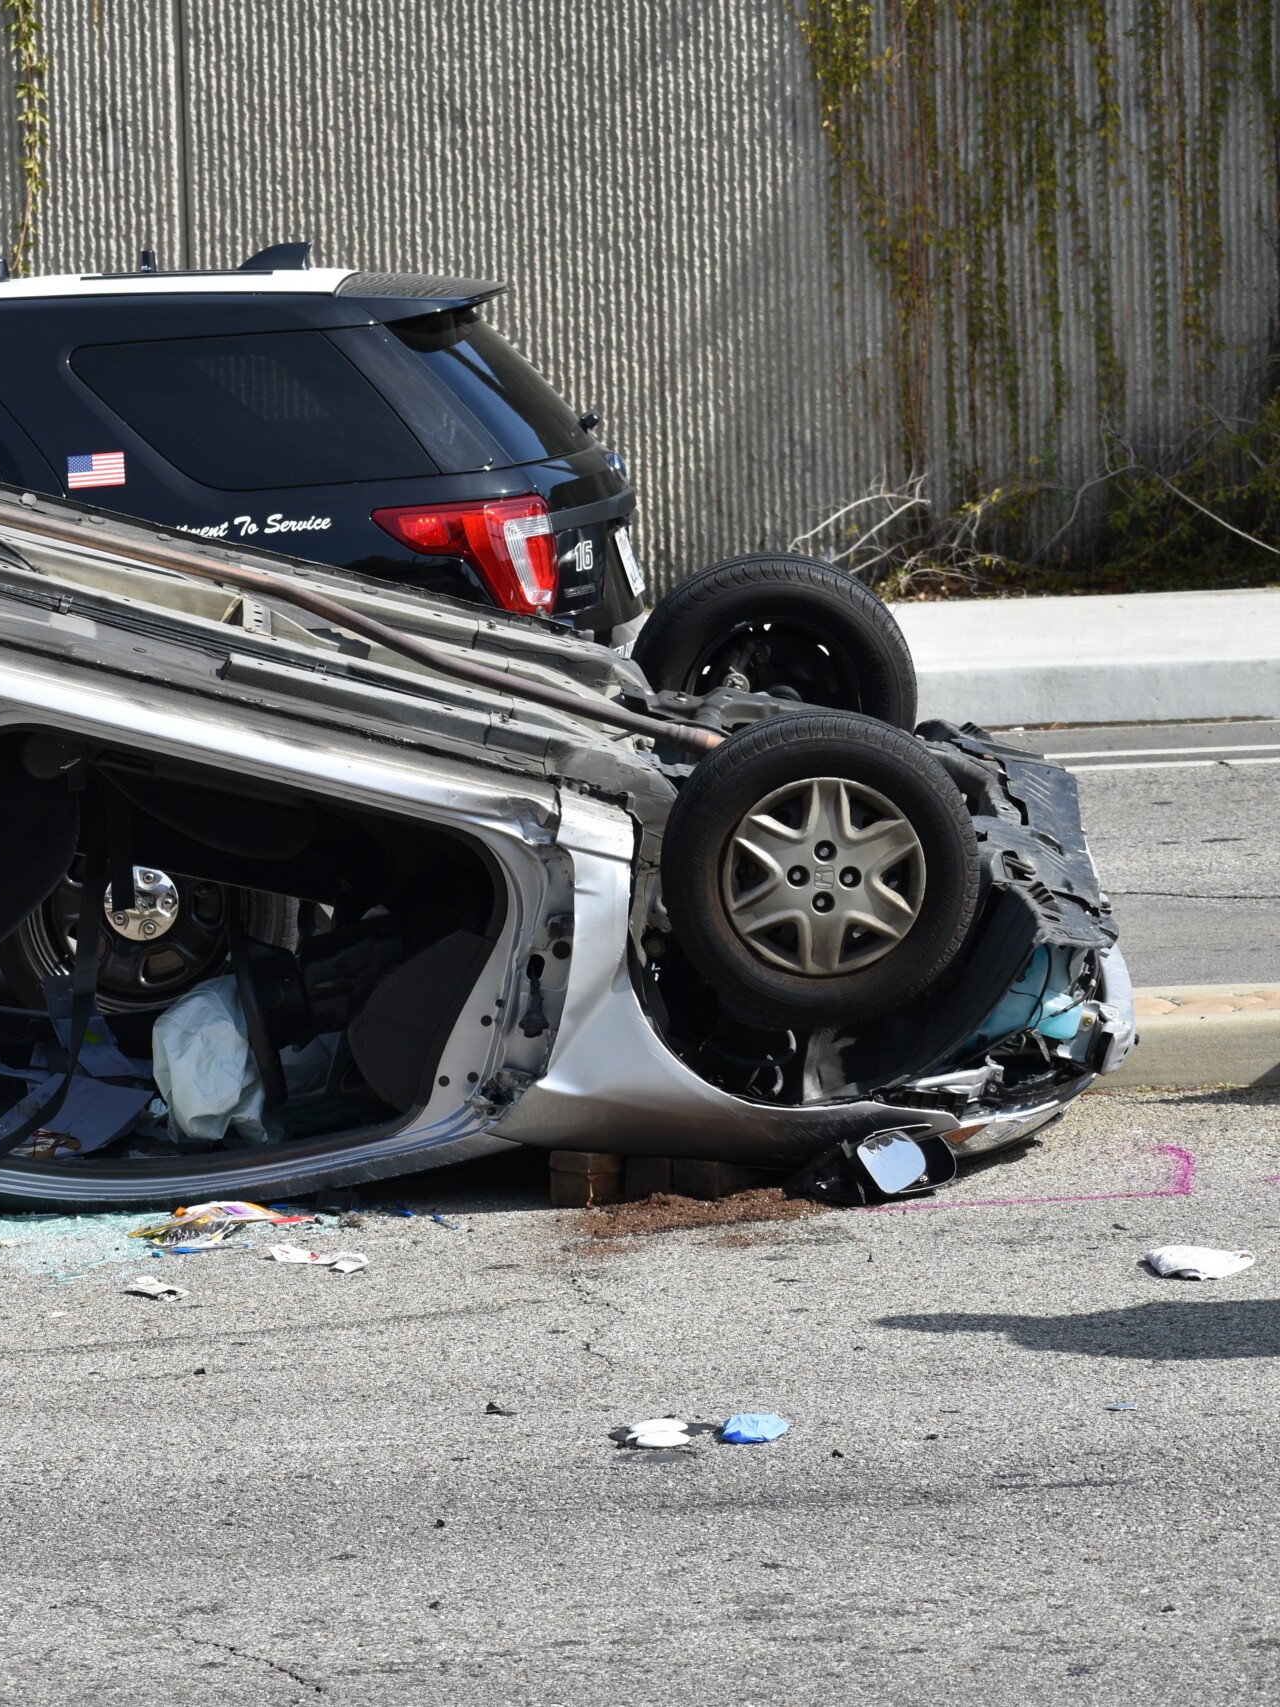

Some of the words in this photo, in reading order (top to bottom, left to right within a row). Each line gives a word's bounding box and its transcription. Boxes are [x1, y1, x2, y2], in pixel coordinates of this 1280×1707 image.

[233, 515, 259, 537] To
[263, 513, 332, 534] Service
[574, 540, 594, 572] 16
